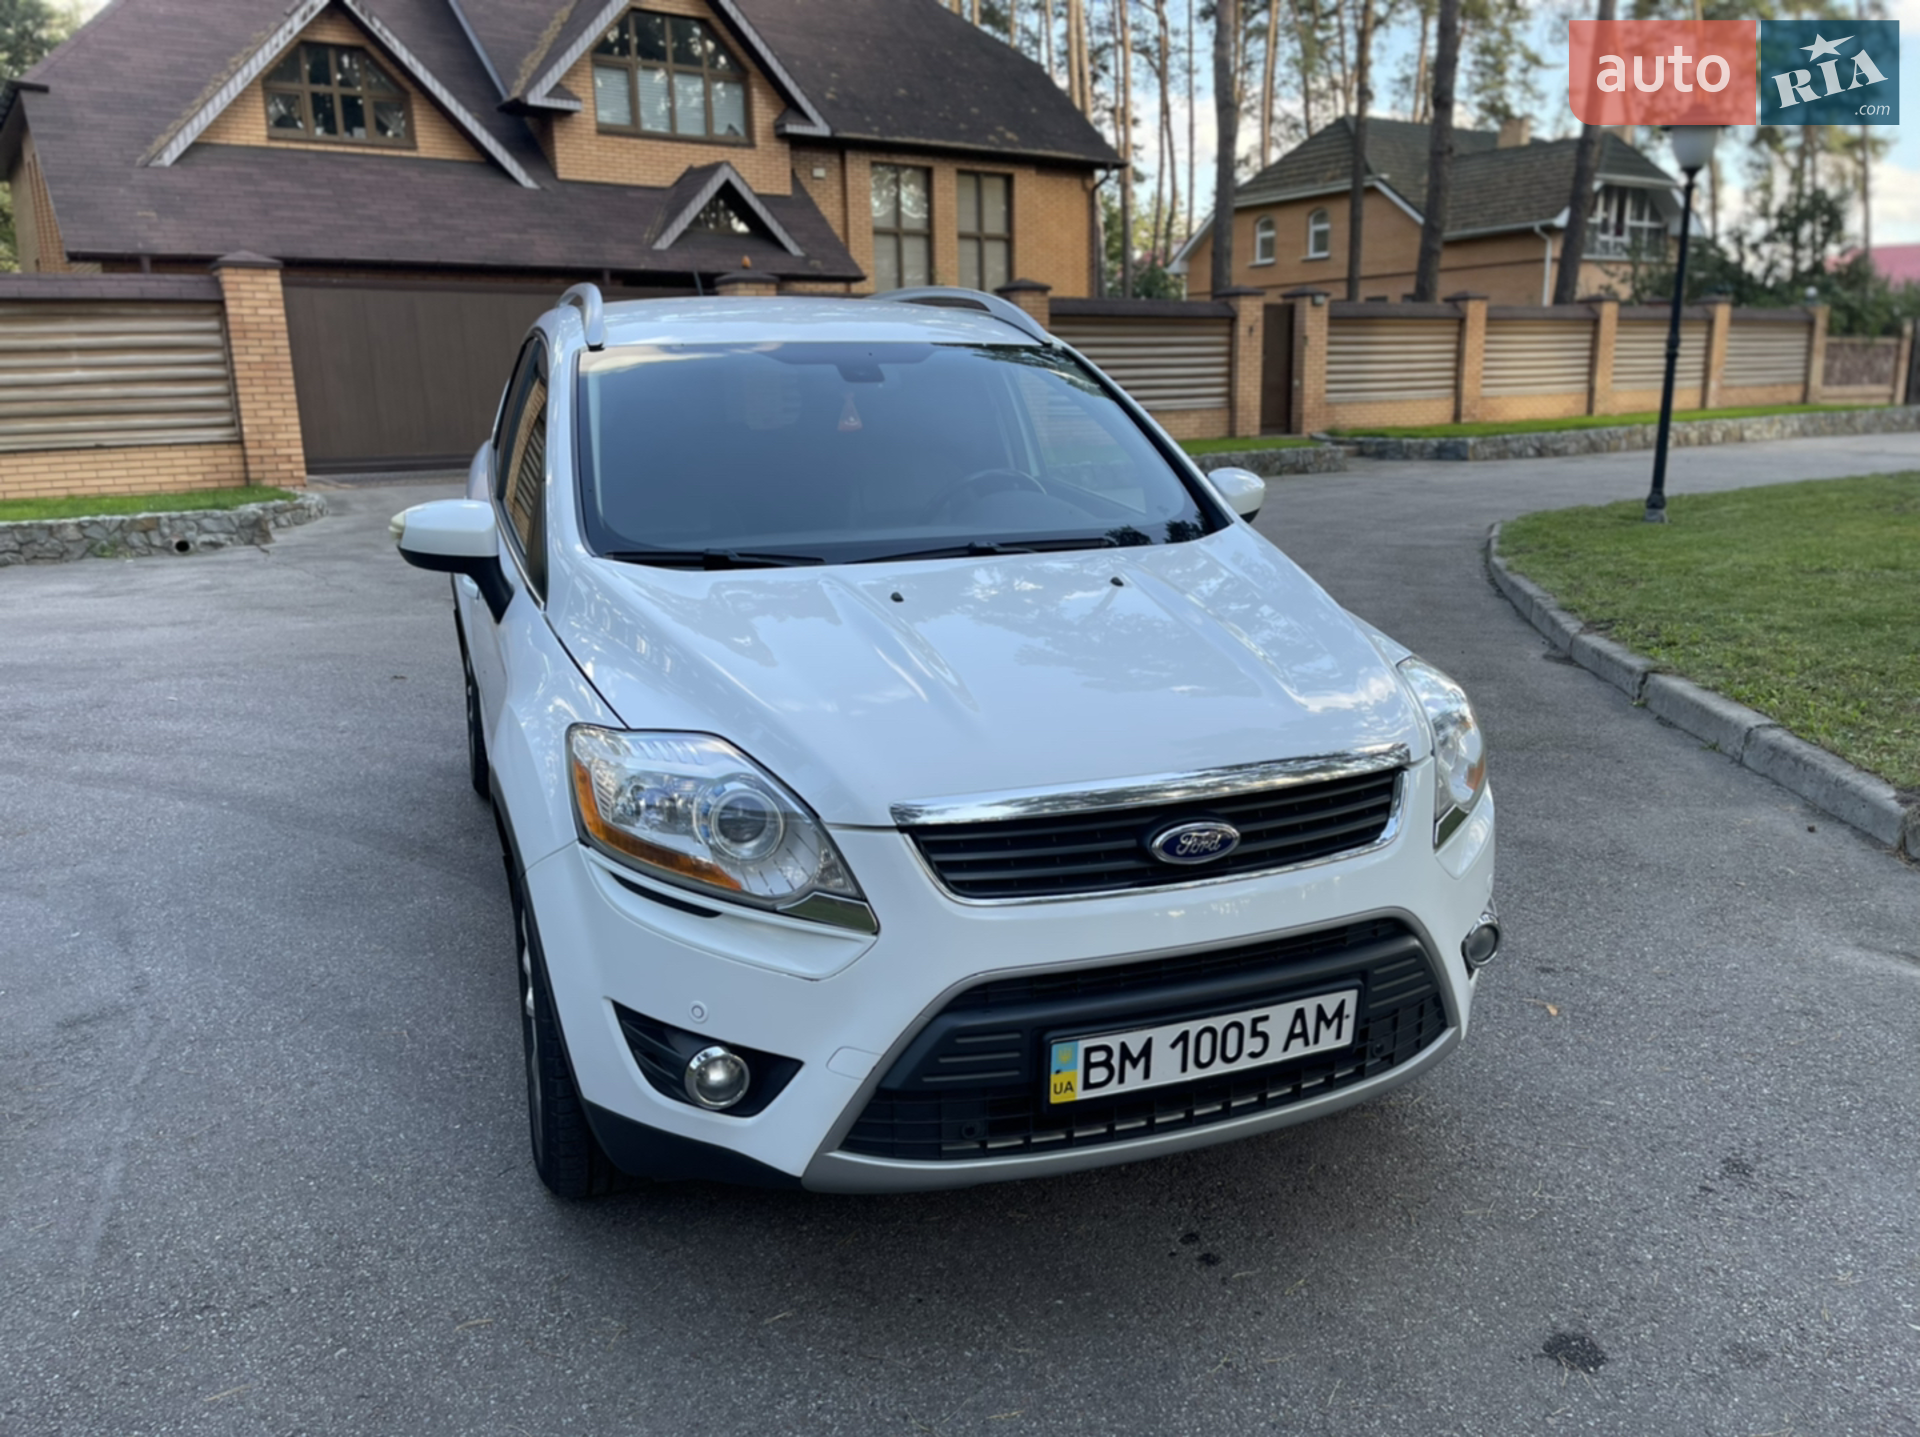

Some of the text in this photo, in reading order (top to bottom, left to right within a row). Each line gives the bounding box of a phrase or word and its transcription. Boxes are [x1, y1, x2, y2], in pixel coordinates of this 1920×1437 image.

[1176, 831, 1221, 856] Ford
[1082, 998, 1347, 1092] BM 1005 AM
[1053, 1080, 1074, 1096] UA
